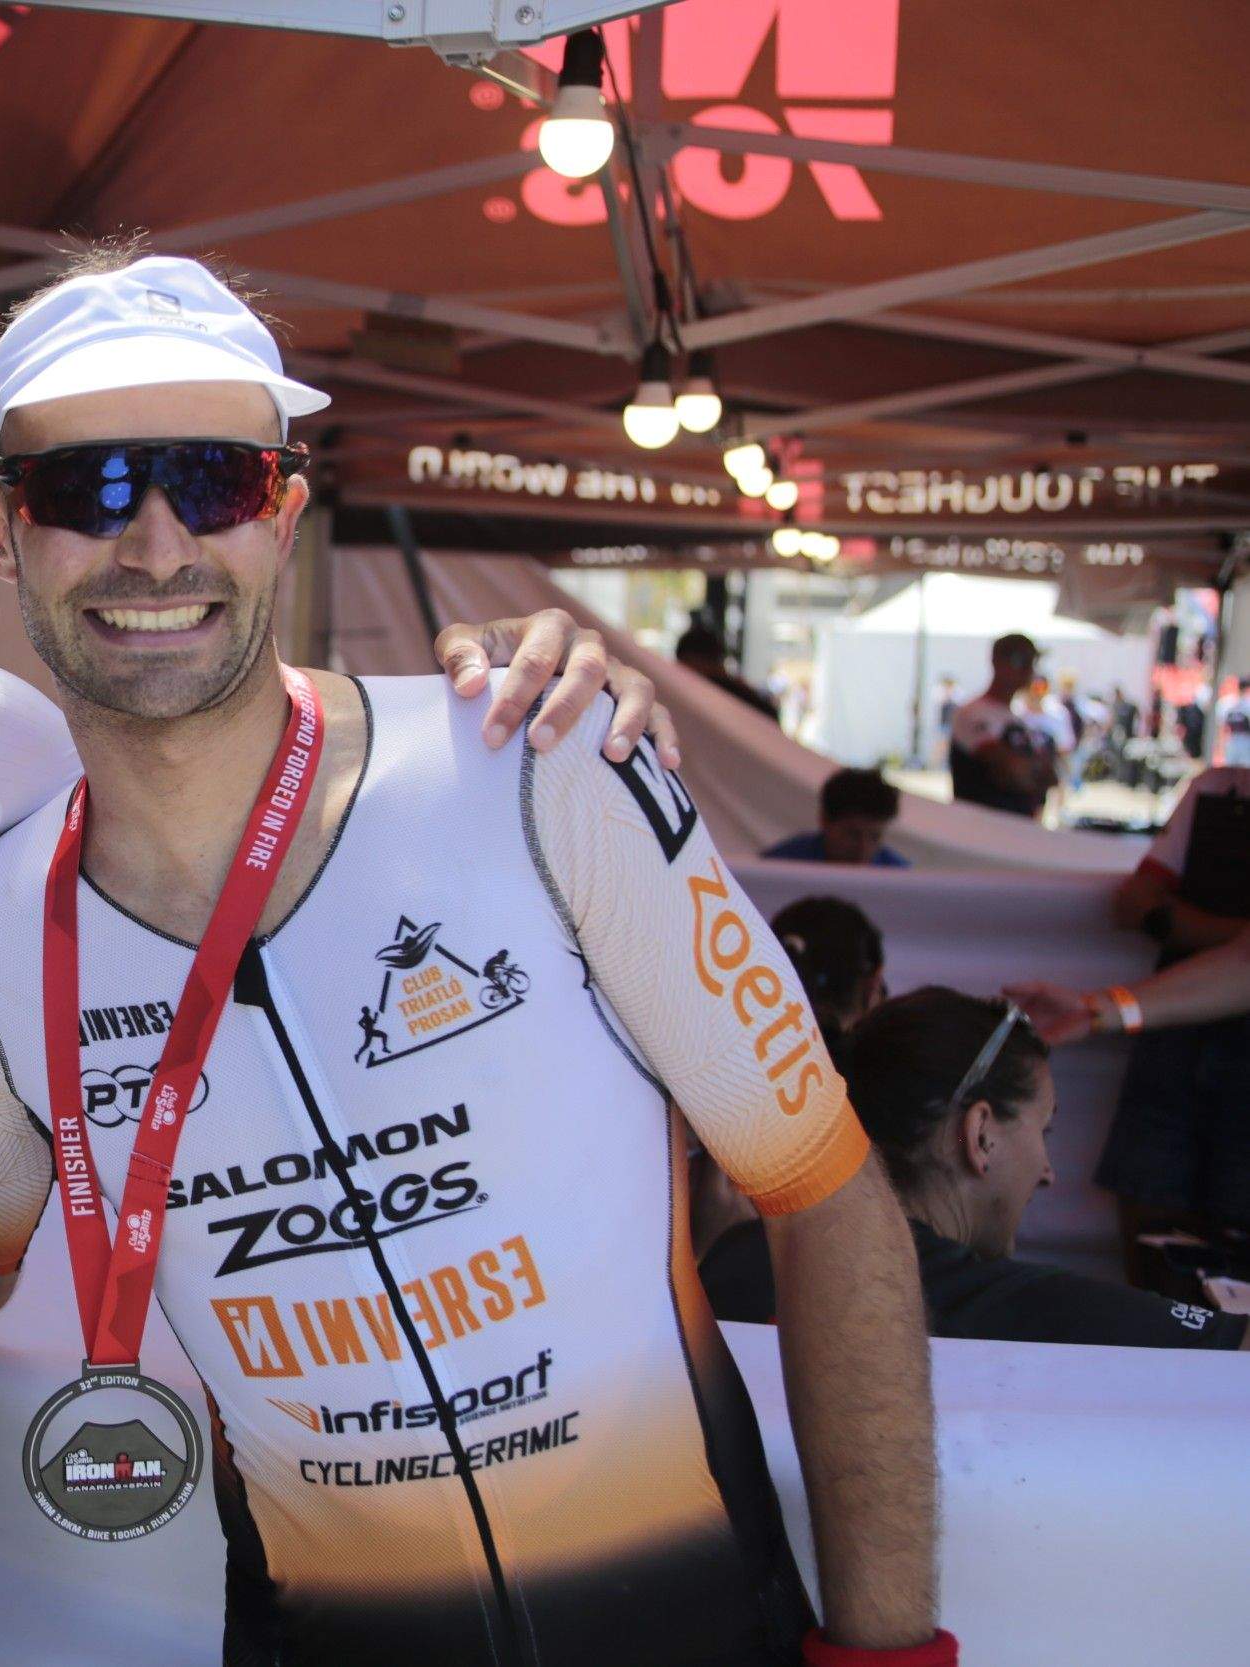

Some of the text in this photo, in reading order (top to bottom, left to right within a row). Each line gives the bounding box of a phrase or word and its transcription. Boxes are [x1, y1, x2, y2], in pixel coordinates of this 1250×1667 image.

[270, 746, 310, 810] FORGED
[245, 831, 278, 871] FIRE
[262, 808, 288, 832] IN
[402, 965, 443, 995] CLUB
[687, 856, 824, 1116] zoetis
[407, 998, 473, 1036] PROSAN
[83, 1078, 153, 1113] PT
[59, 1116, 96, 1217] FINISHER
[166, 1103, 470, 1209] SALOMON
[207, 1161, 480, 1278] ZOGGS
[292, 1235, 547, 1366] INVERSE
[100, 1375, 139, 1387] EDITION
[319, 1348, 553, 1433] infisport
[300, 1411, 580, 1487] CYCLINGCERAMIC
[35, 1491, 53, 1517] SWIM
[87, 1529, 110, 1540] BIKE
[112, 1525, 146, 1540] 180KM
[150, 1510, 171, 1528] RUN
